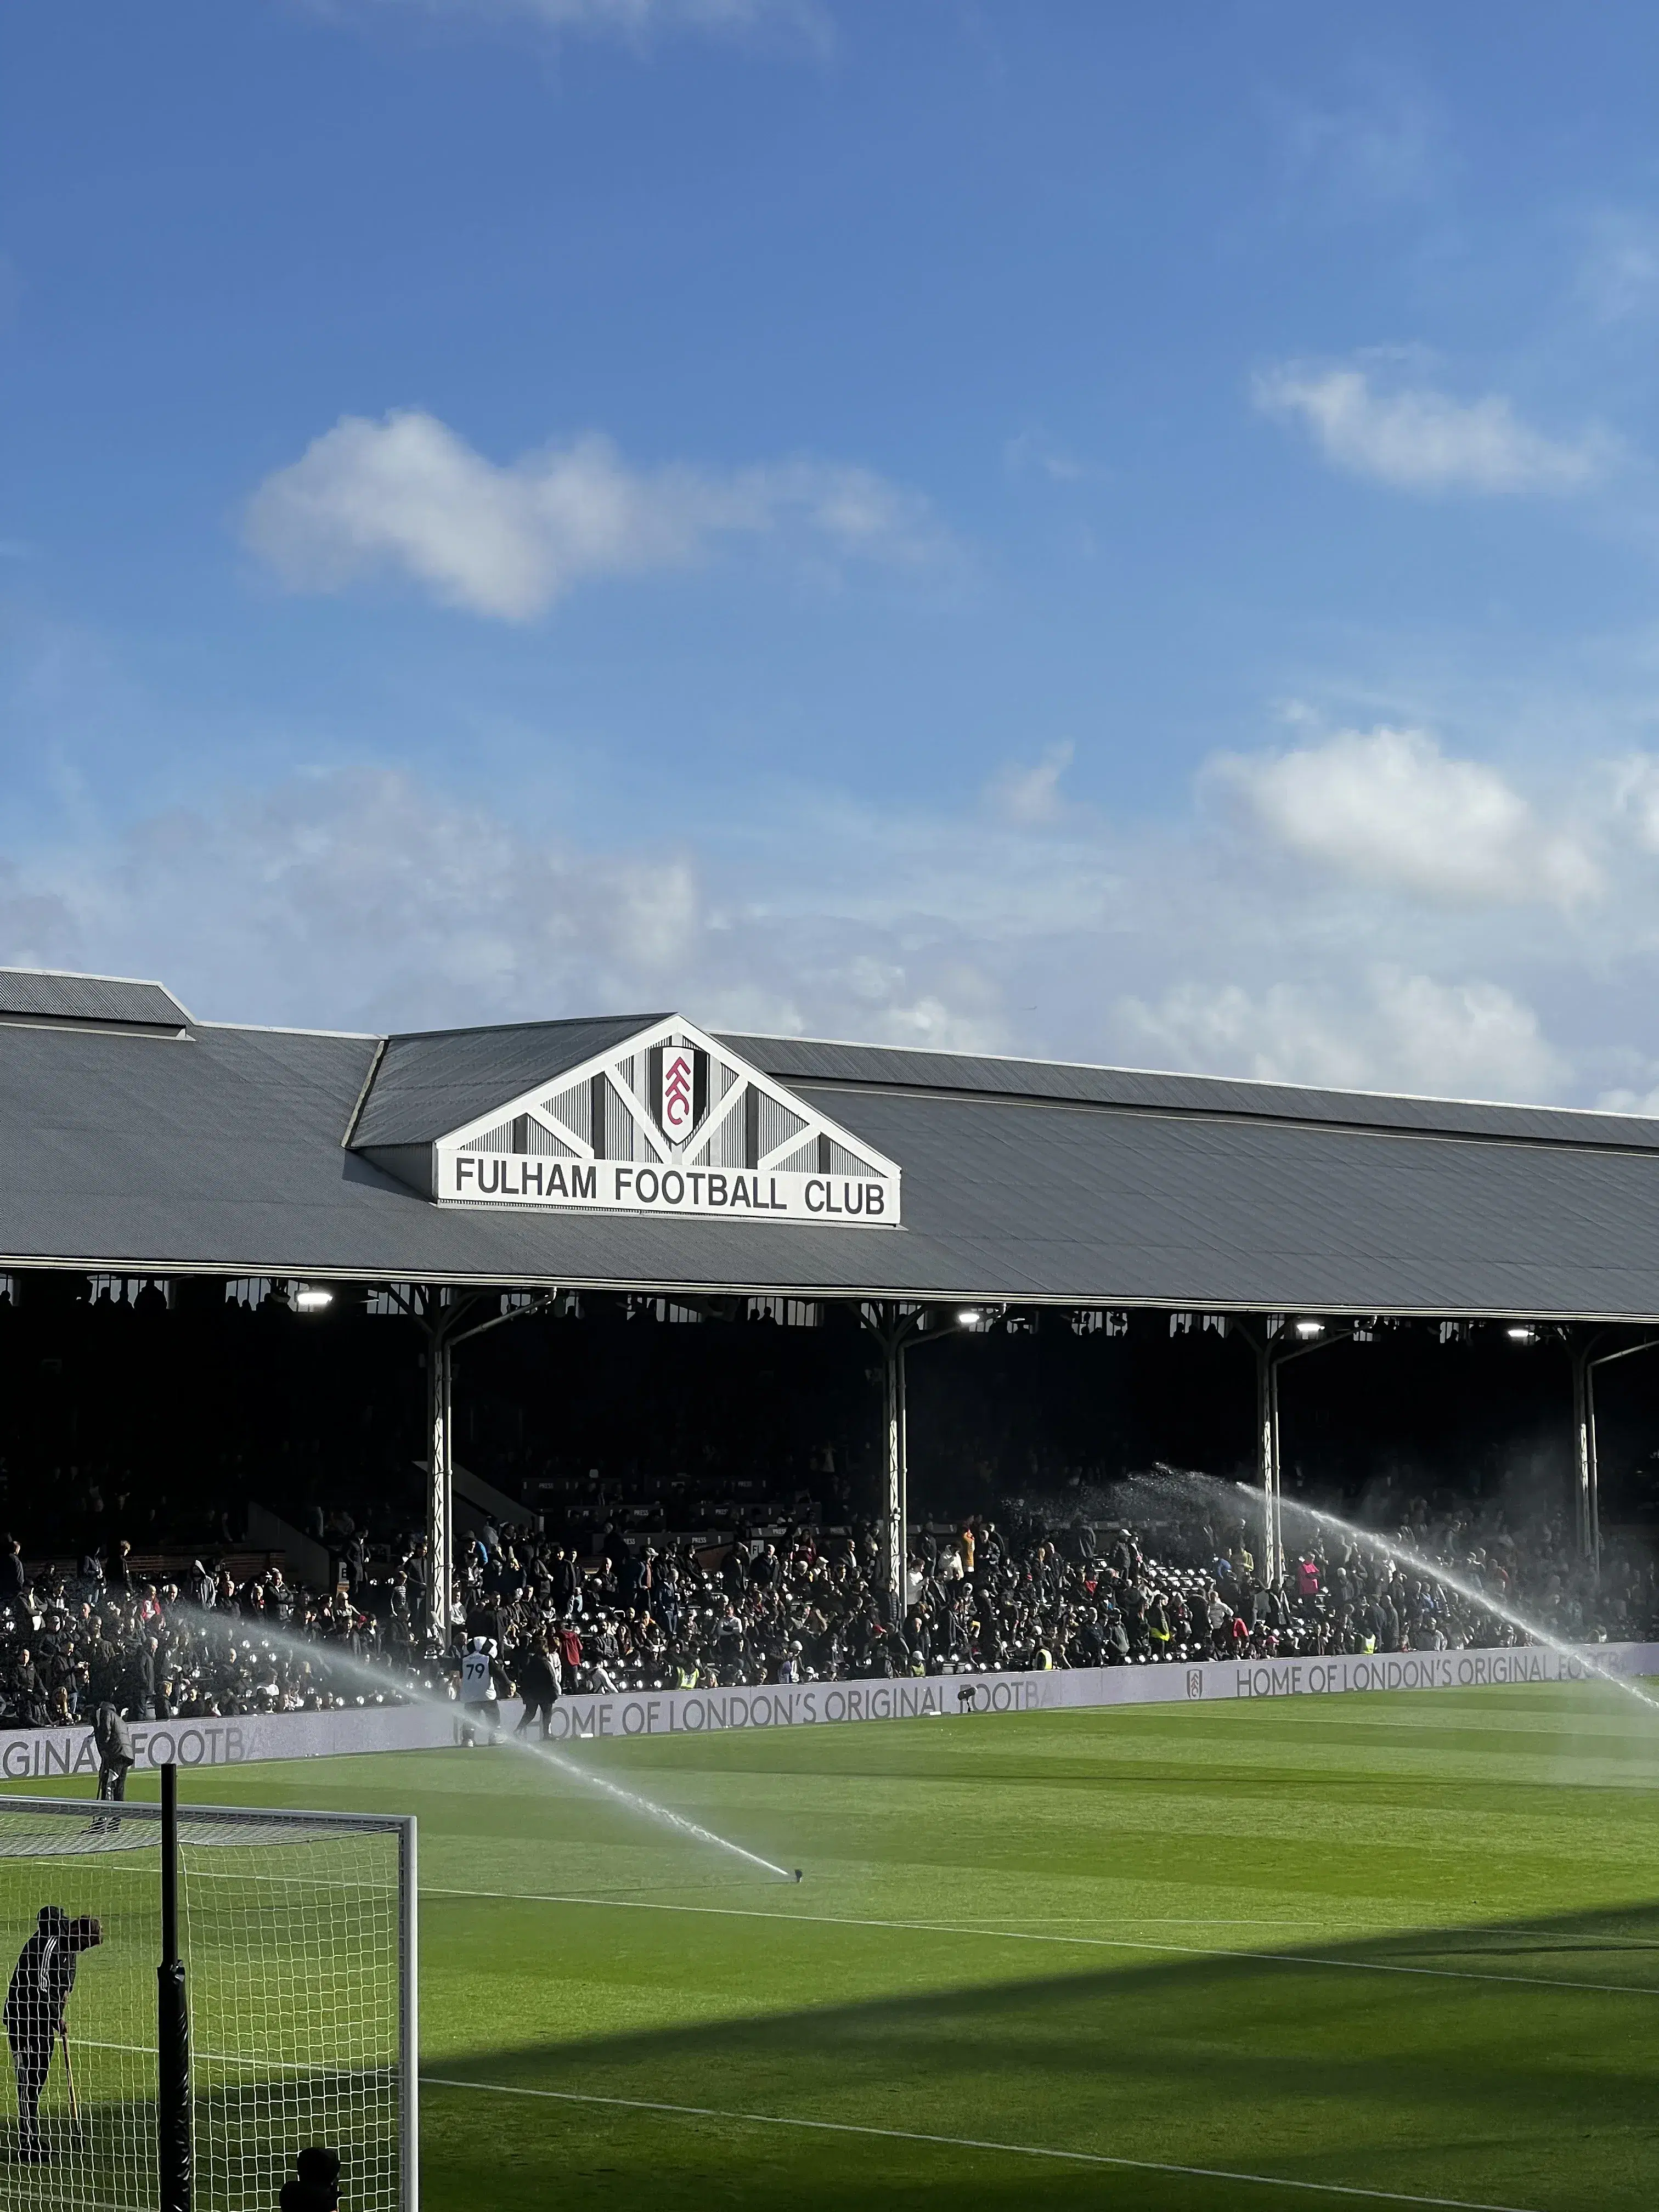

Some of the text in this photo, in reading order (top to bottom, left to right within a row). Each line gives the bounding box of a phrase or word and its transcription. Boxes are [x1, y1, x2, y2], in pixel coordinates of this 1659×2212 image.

[456, 1158, 884, 1215] FULHAM FOOTBALL CLUB
[466, 1663, 485, 1680] 79
[1237, 1666, 1303, 1697] HOME
[1309, 1664, 1337, 1693] OF
[1344, 1659, 1452, 1691] LONDON'S
[1458, 1654, 1553, 1685] ORIGINAL
[622, 1701, 661, 1735] OF
[669, 1693, 816, 1732] LONDON'S
[825, 1685, 951, 1722] ORIGINAL
